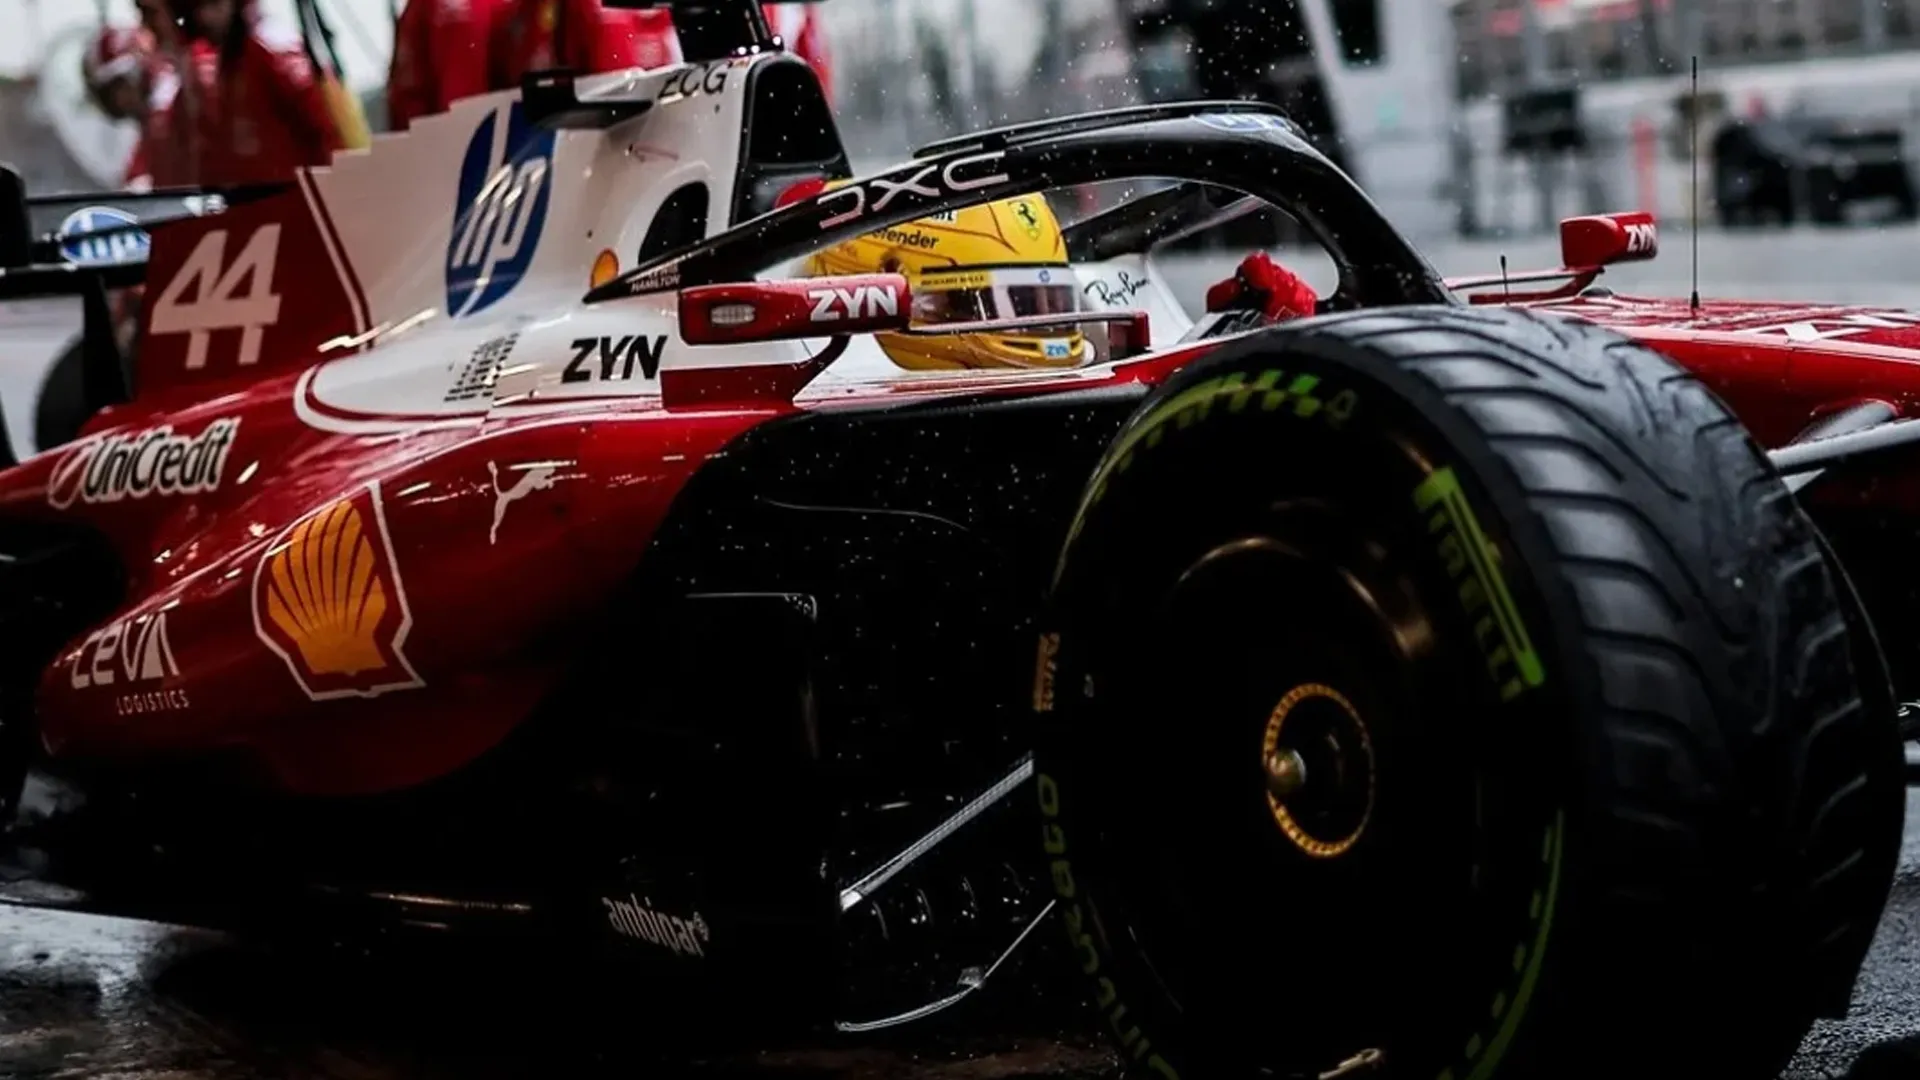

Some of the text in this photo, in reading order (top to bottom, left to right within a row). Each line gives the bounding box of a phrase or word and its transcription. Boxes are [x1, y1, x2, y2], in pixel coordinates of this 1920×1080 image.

[816, 149, 1009, 230] DXC
[1623, 223, 1657, 252] ZYN
[150, 223, 281, 370] 44
[808, 285, 899, 322] ZYN
[561, 334, 669, 384] ZYN
[82, 417, 242, 503] UniCredit
[116, 688, 190, 716] LOGISTICS
